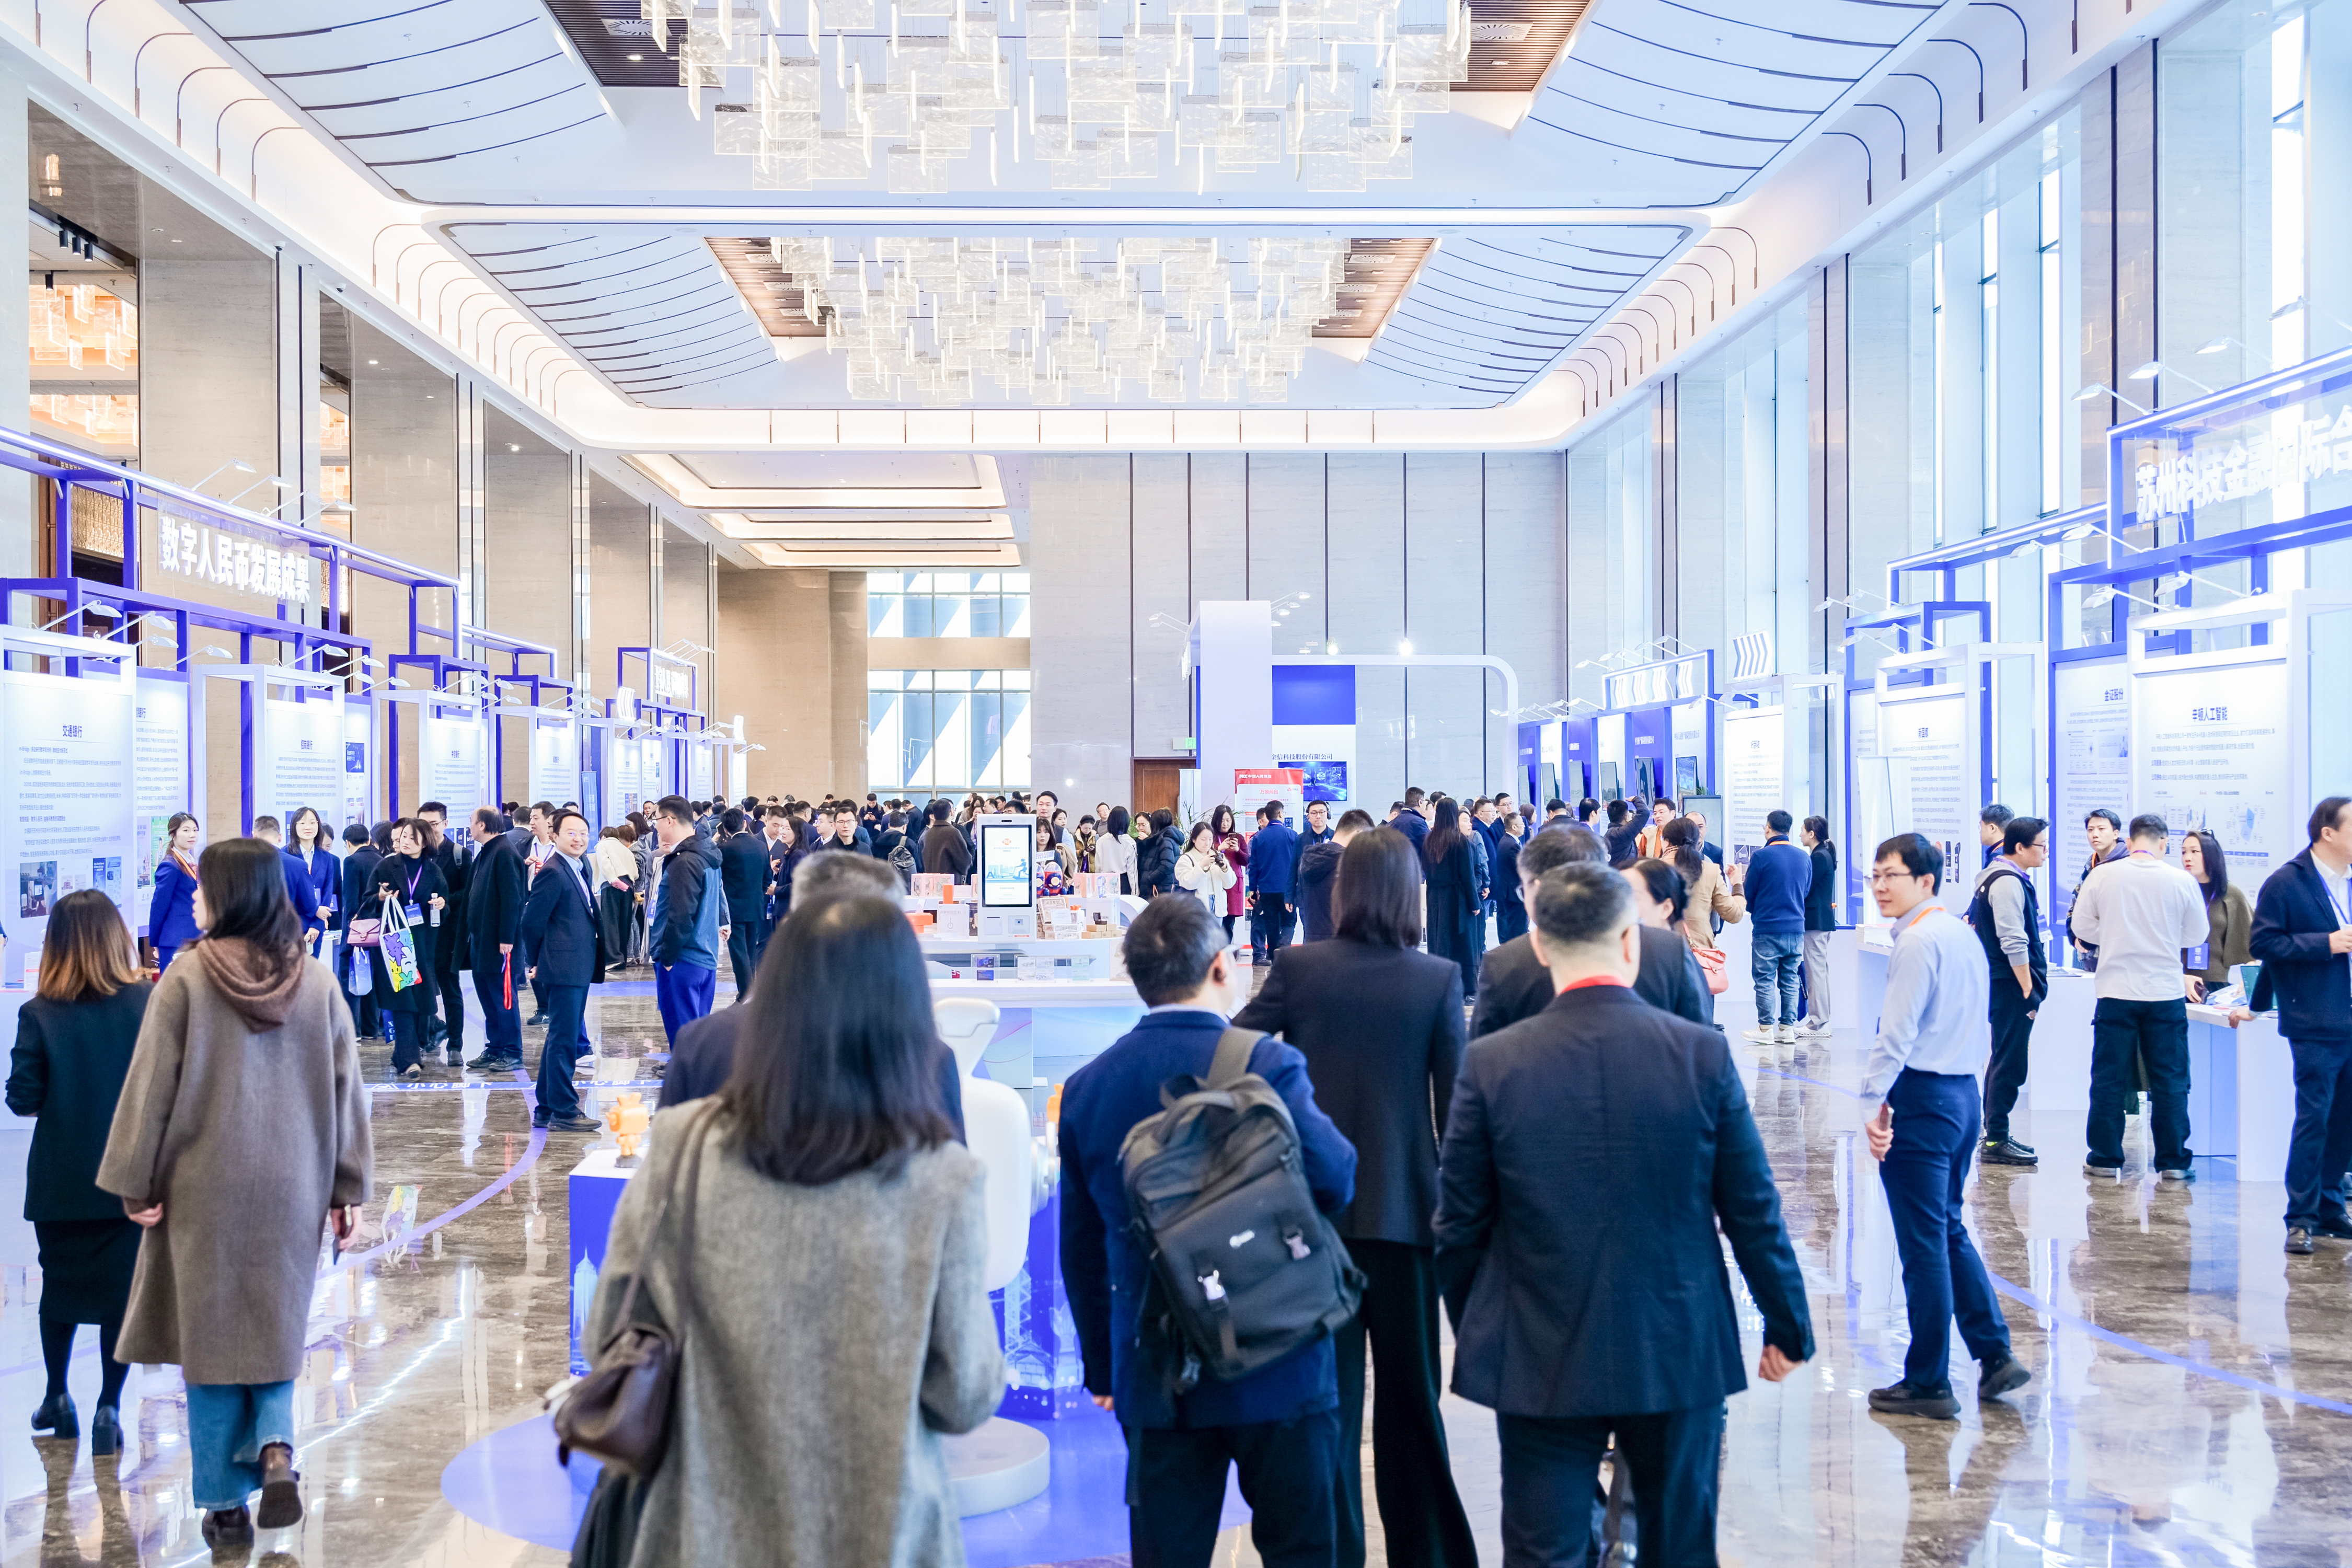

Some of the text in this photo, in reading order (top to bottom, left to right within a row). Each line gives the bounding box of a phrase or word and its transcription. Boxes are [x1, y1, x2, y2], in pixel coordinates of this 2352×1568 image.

[160, 516, 310, 603] 数字人民币发展成果
[2105, 688, 2123, 701] 金证股份
[63, 724, 82, 738] 交通银行
[301, 740, 313, 750] 招商银行
